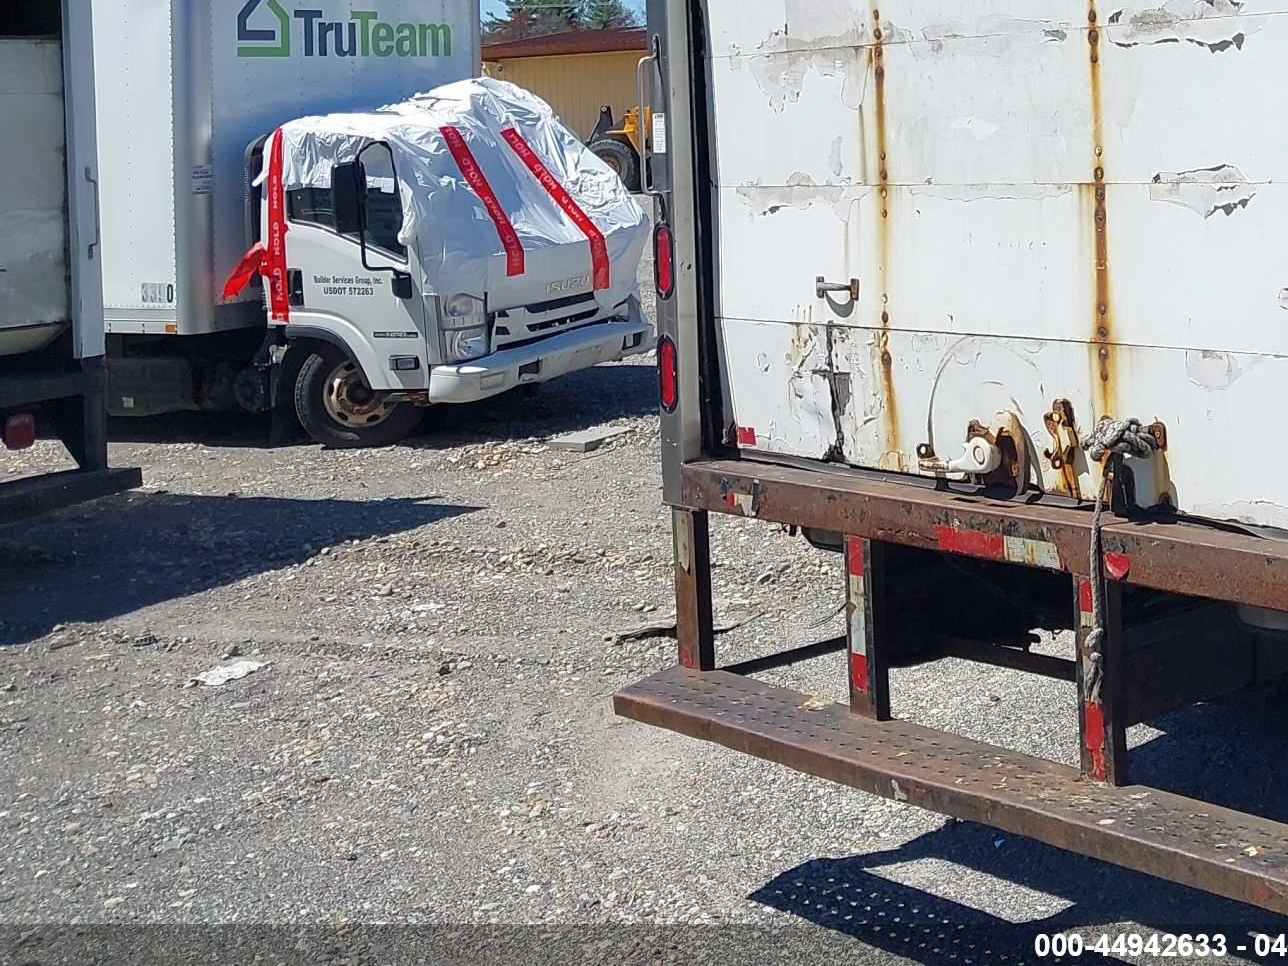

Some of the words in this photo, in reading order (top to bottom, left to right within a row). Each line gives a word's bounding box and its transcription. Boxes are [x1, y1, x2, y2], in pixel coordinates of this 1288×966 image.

[294, 9, 452, 57] TruTeam
[332, 275, 354, 284] Services
[546, 273, 590, 294] ISUZU
[323, 287, 347, 295] USDOT
